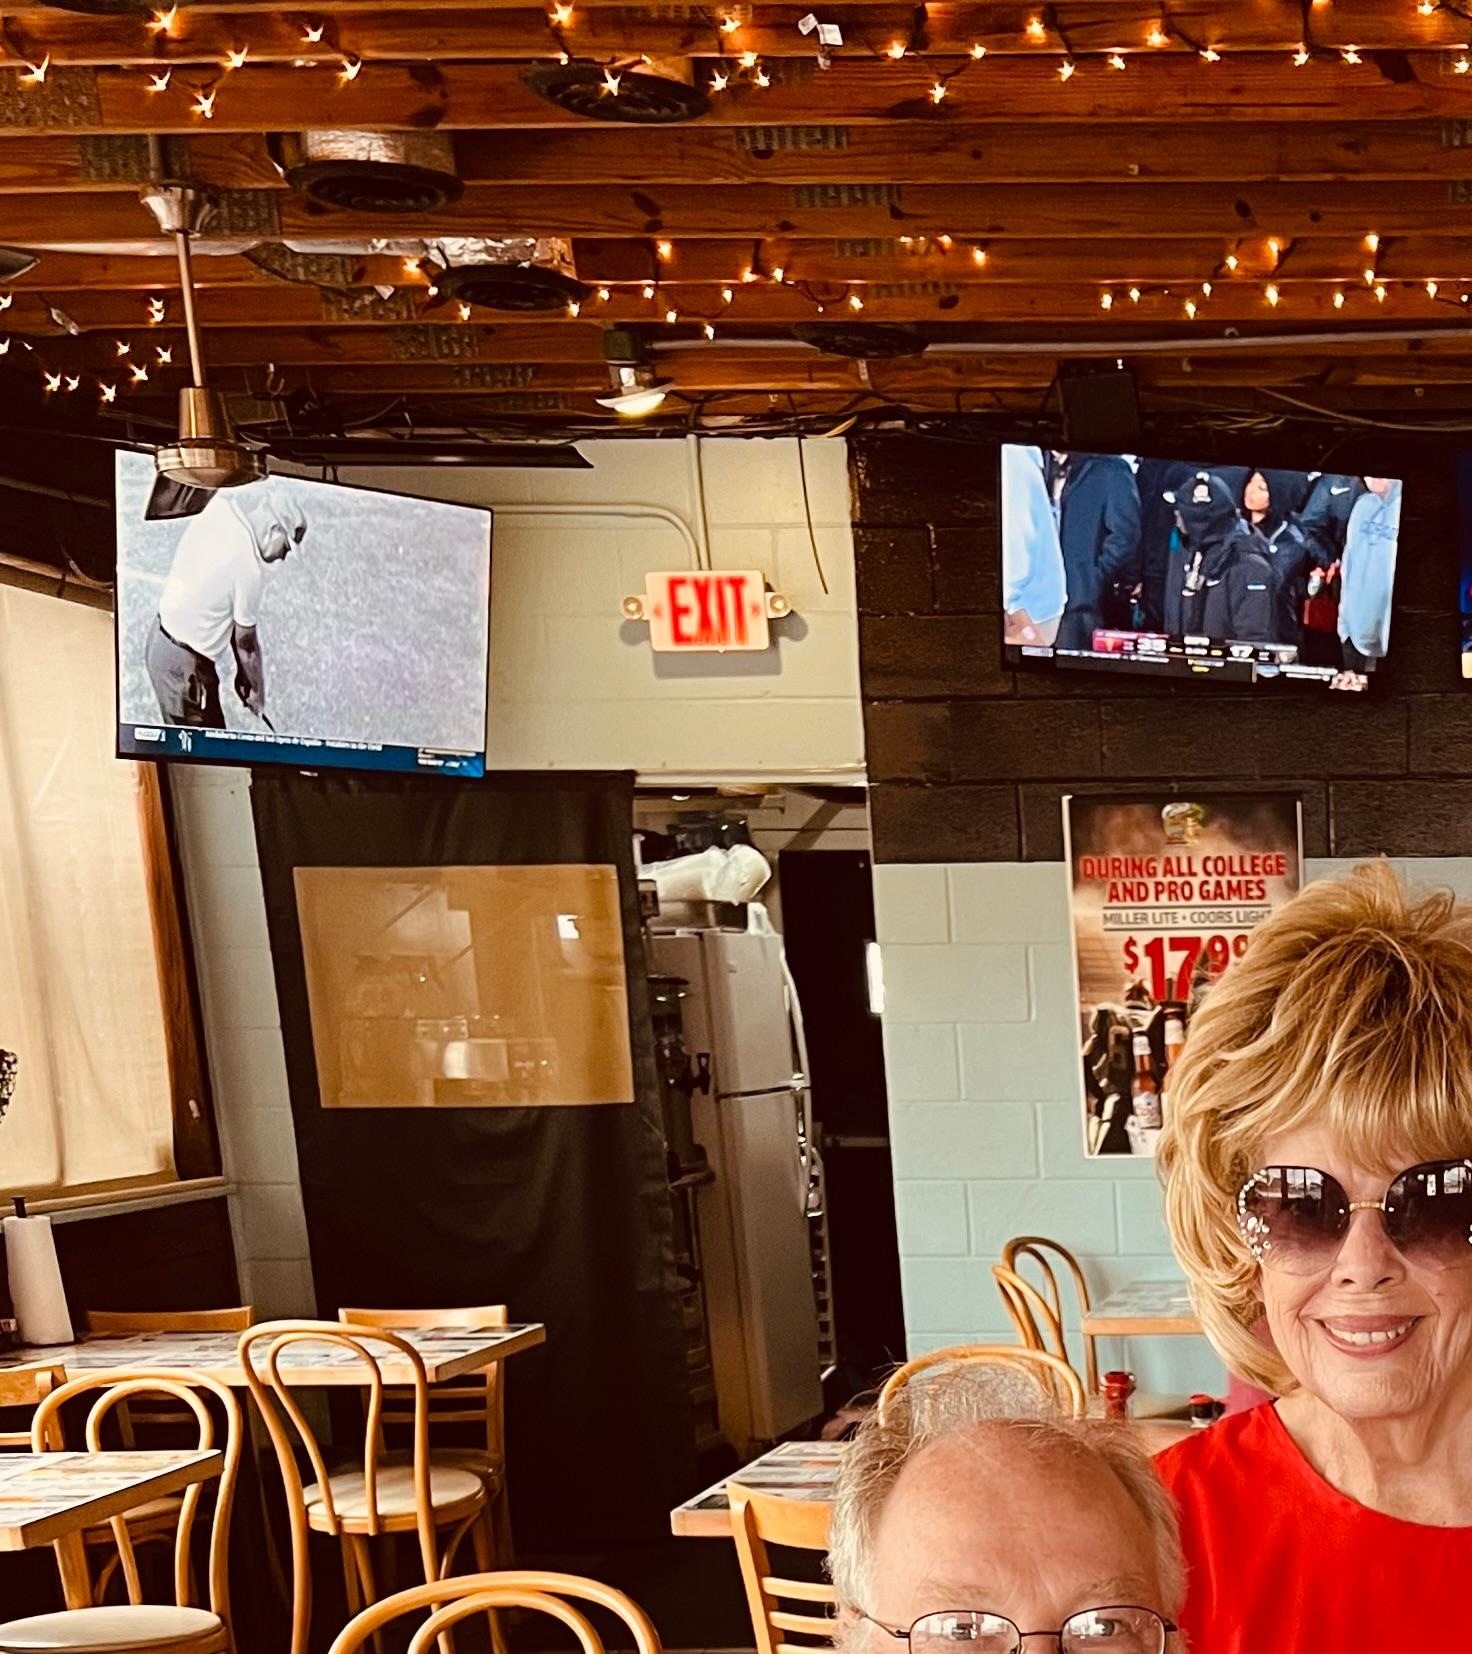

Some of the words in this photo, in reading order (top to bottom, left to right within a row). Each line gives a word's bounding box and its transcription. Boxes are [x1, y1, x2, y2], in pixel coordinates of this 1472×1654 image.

[668, 577, 748, 645] EXIT
[1081, 857, 1157, 879] DURING
[1163, 856, 1198, 878] ALL
[1203, 853, 1286, 877] COLLEGE
[1108, 880, 1149, 903] AND
[1154, 880, 1193, 902] PRO
[1199, 879, 1266, 901] GAMES
[1103, 910, 1149, 924] MILLER
[1152, 909, 1177, 923] LITE
[1190, 909, 1234, 923] COORS
